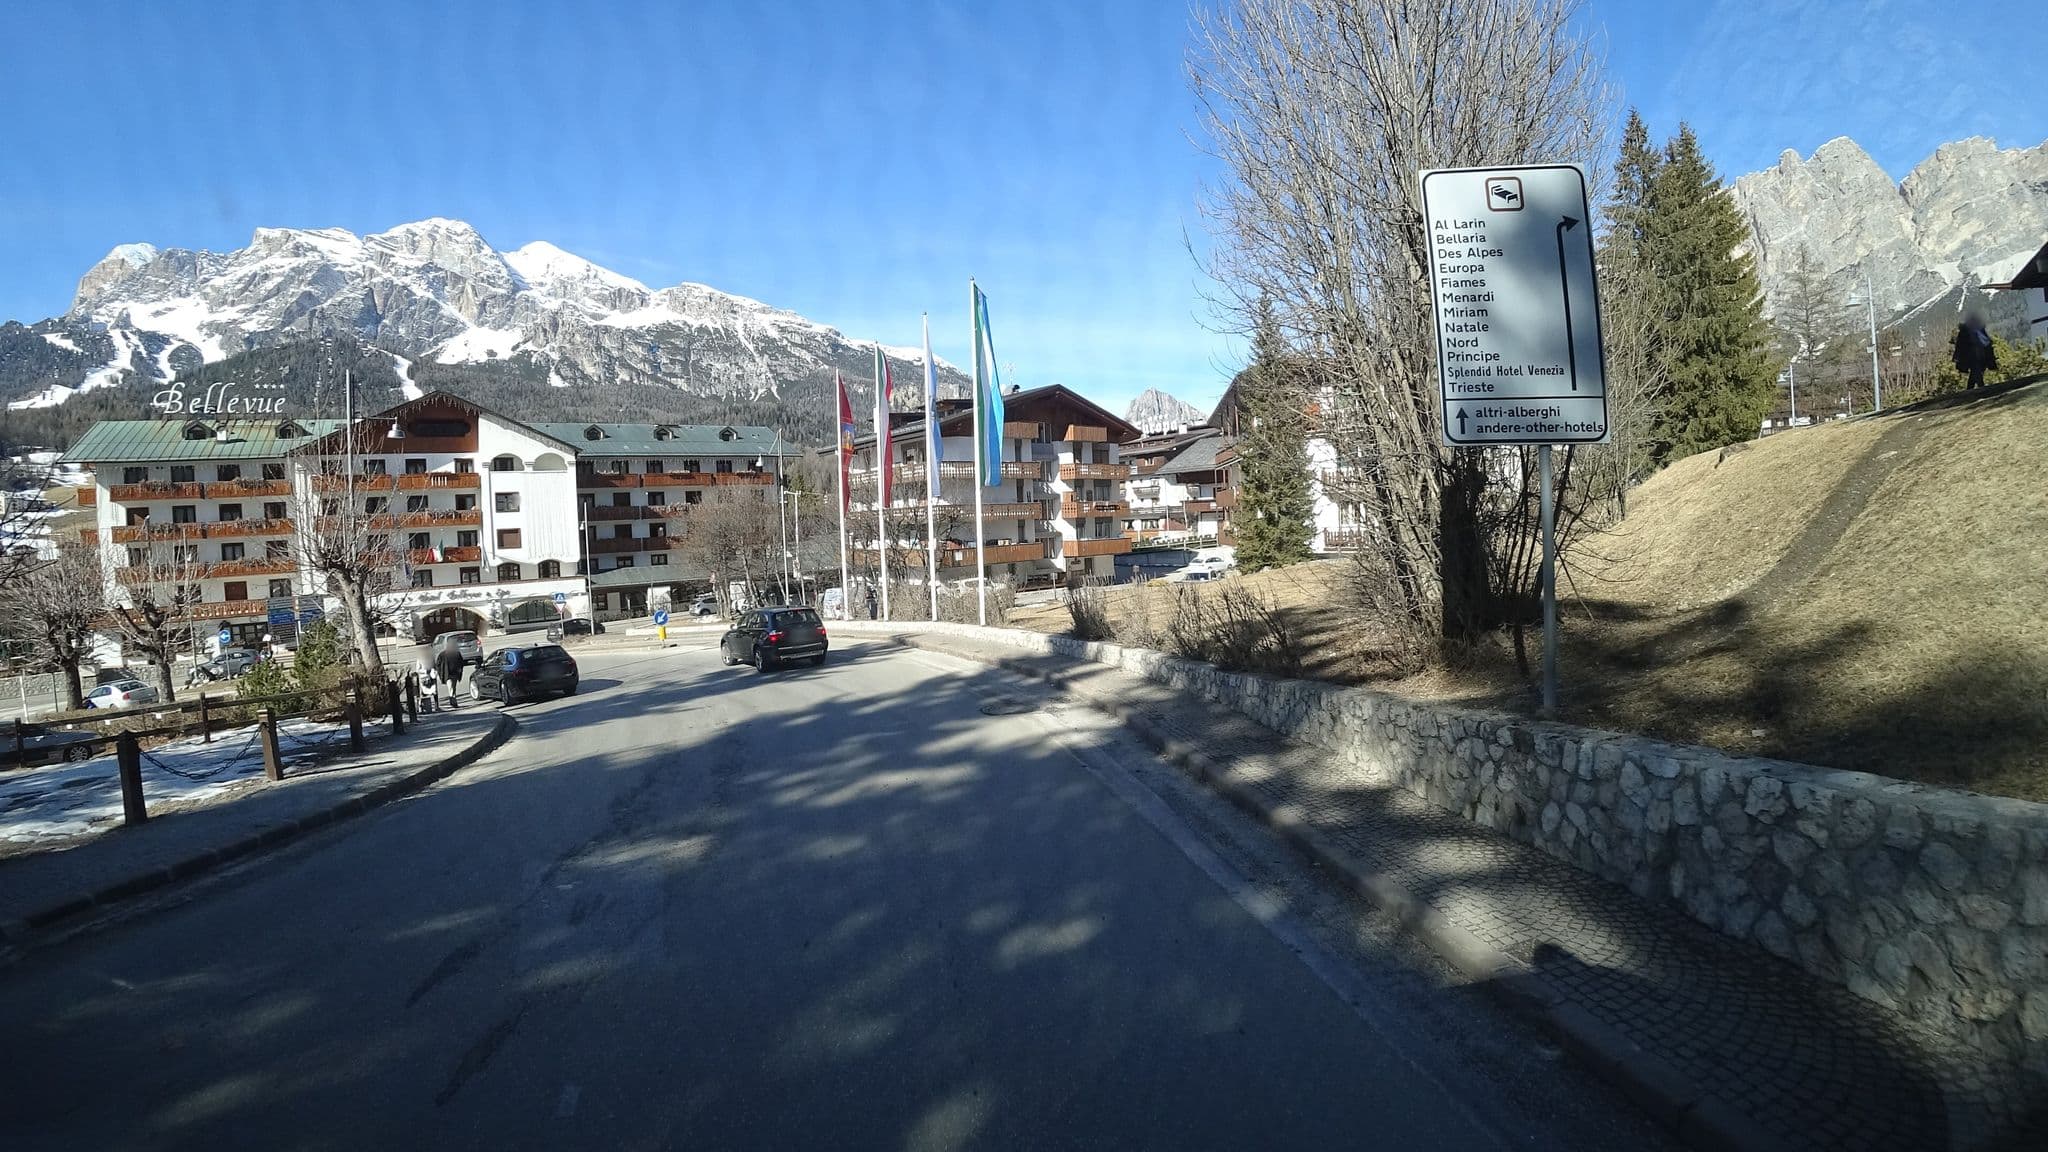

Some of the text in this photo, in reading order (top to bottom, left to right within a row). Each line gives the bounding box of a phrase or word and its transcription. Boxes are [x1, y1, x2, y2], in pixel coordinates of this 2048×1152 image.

[1435, 218, 1486, 230] Al Larin
[1436, 232, 1487, 245] Bellaria
[1438, 247, 1504, 260] Des Alpes
[1440, 263, 1485, 275] Europa
[1441, 277, 1486, 289] Fiames
[1442, 291, 1495, 303] Menardi
[1444, 306, 1489, 318] Miriam
[1445, 321, 1489, 333] Natale
[1446, 336, 1479, 348] Nord
[1447, 350, 1501, 363] Principe
[1448, 364, 1565, 379] Splendid Hotel Venezia
[1449, 381, 1495, 393] Trieste
[149, 382, 286, 414] Bellevue
[1475, 406, 1561, 419] altri-alberghi
[1476, 421, 1604, 434] andere-other-hotels
